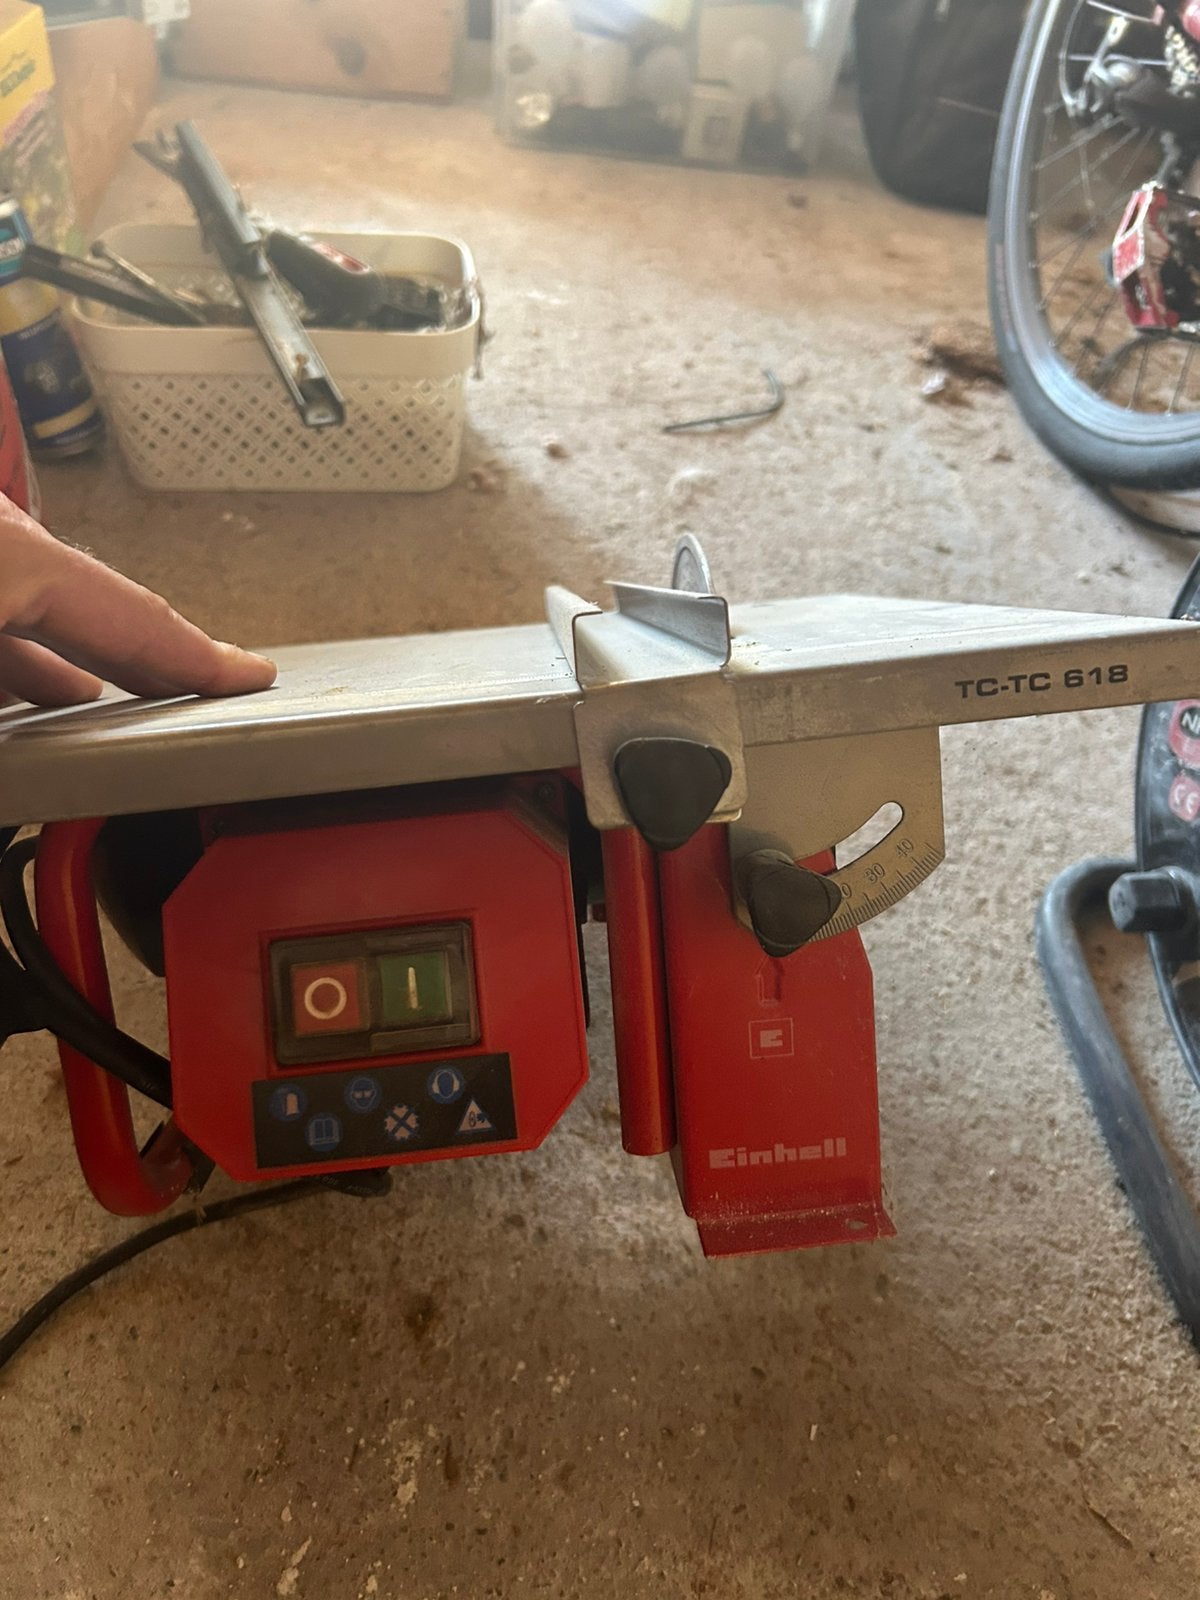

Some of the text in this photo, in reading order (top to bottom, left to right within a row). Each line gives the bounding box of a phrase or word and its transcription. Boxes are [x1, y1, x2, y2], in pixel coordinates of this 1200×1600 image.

[954, 664, 1129, 698] TC-TC 618
[895, 838, 915, 858] 40
[864, 862, 887, 884] 30
[708, 1137, 848, 1170] Einhell
